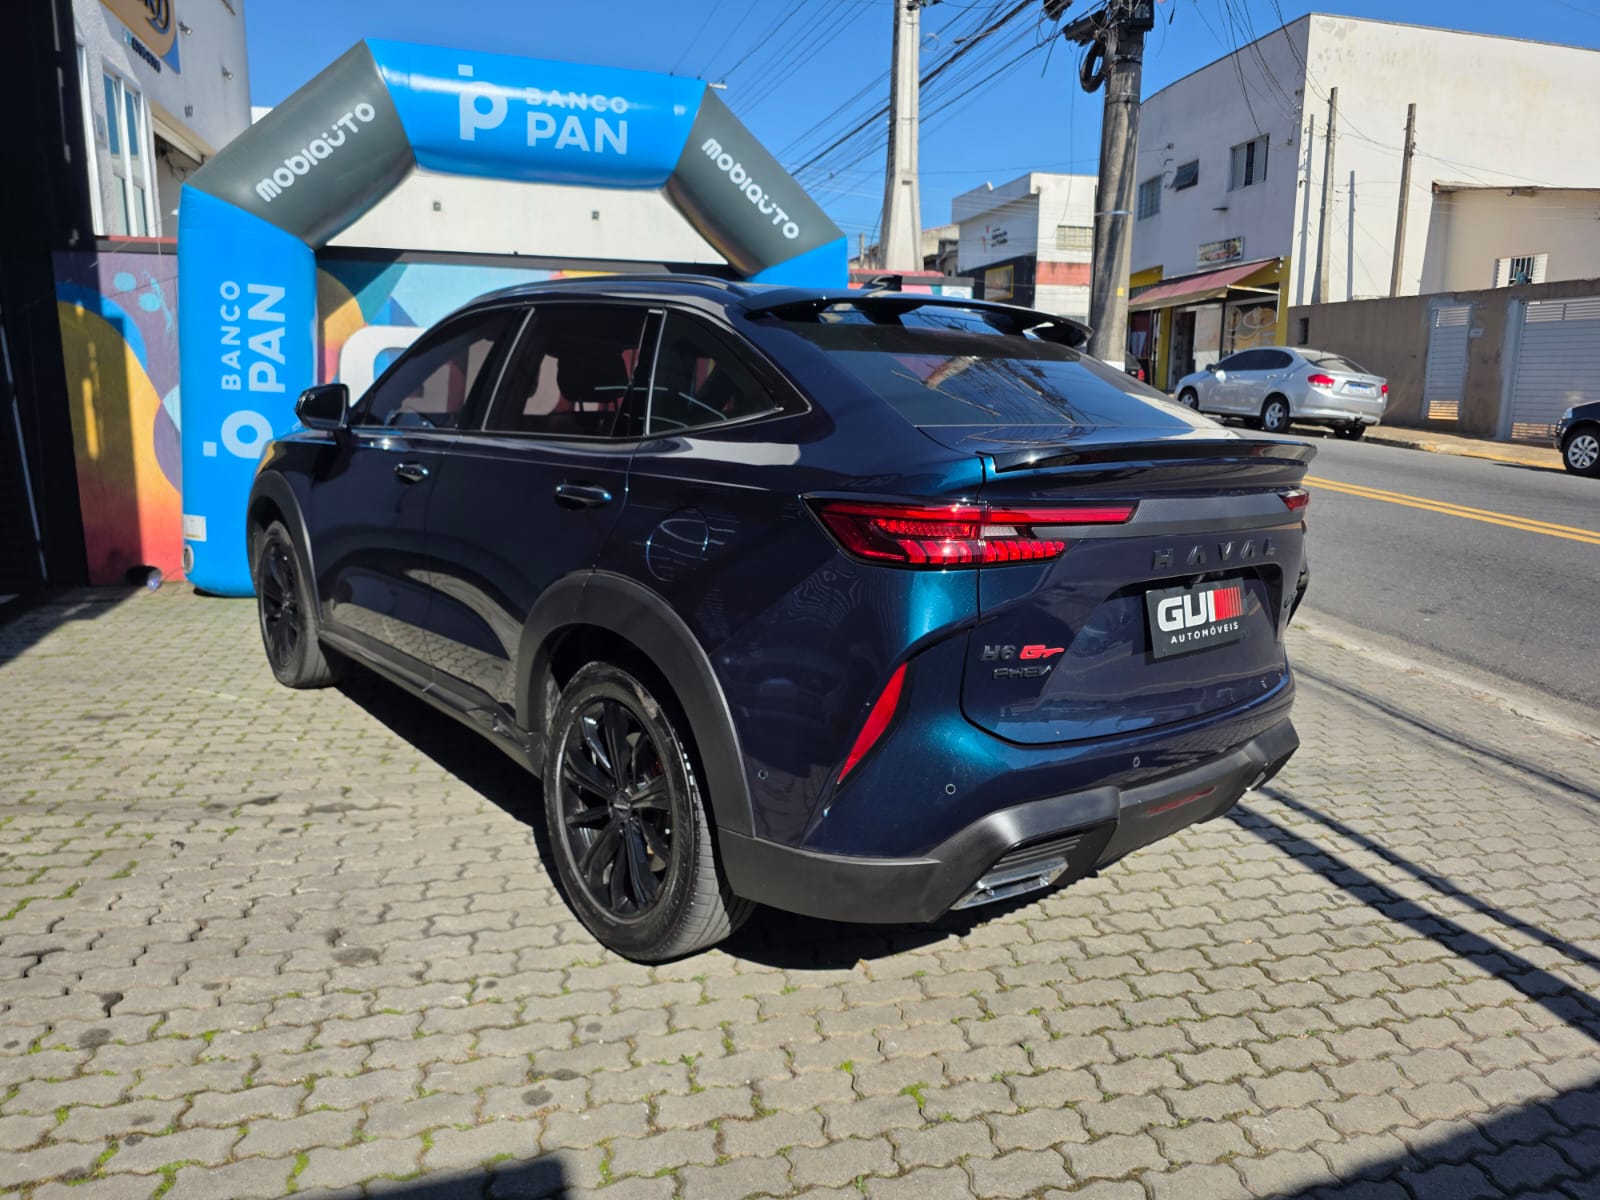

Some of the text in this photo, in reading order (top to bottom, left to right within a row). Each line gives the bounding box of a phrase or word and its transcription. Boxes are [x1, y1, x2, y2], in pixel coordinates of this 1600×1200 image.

[525, 87, 628, 114] BANCO
[526, 111, 628, 155] PAN
[219, 281, 242, 391] BANCO
[247, 283, 286, 393] PAN
[1152, 537, 1277, 571] HAVAL
[1157, 590, 1217, 632] GUI
[1170, 621, 1240, 645] AUTOMÓVEIS
[981, 645, 1017, 661] H6
[993, 664, 1053, 680] PHEV
